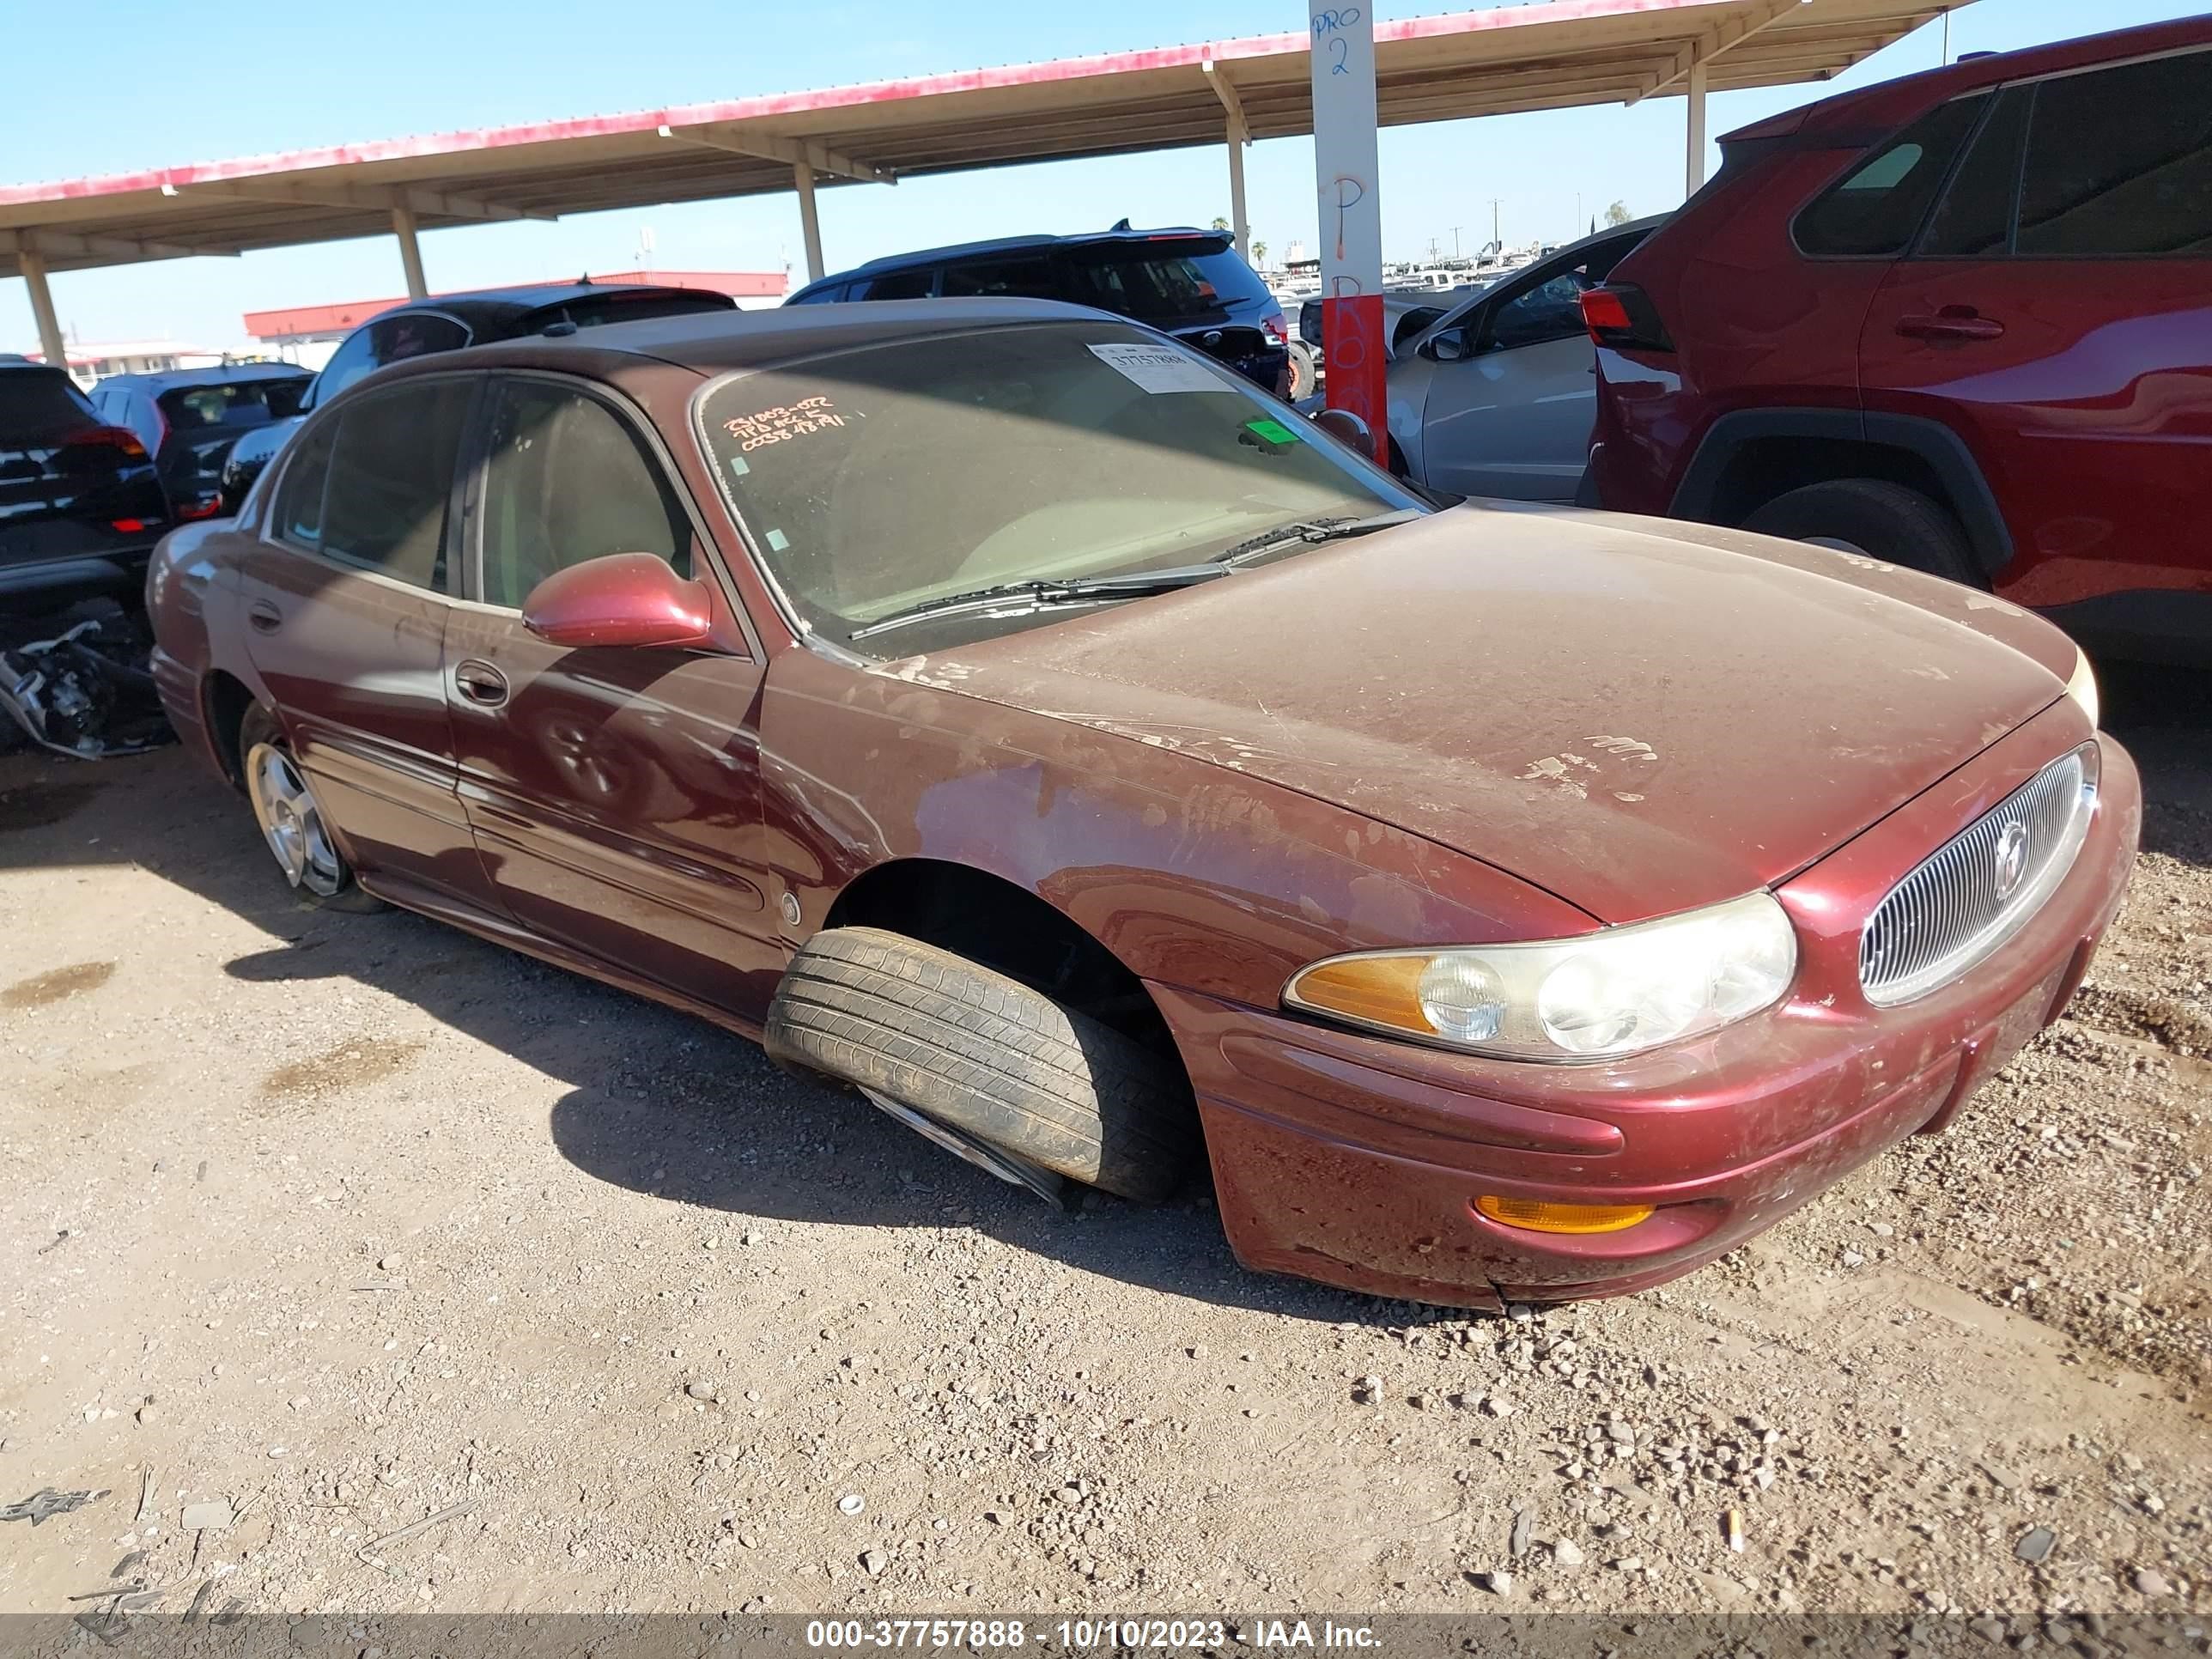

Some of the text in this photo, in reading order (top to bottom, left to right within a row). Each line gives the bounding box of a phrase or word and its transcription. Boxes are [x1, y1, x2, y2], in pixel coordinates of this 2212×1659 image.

[1311, 7, 1361, 41] PRO
[1328, 37, 1350, 76] 2
[1110, 354, 1188, 368] 37757888
